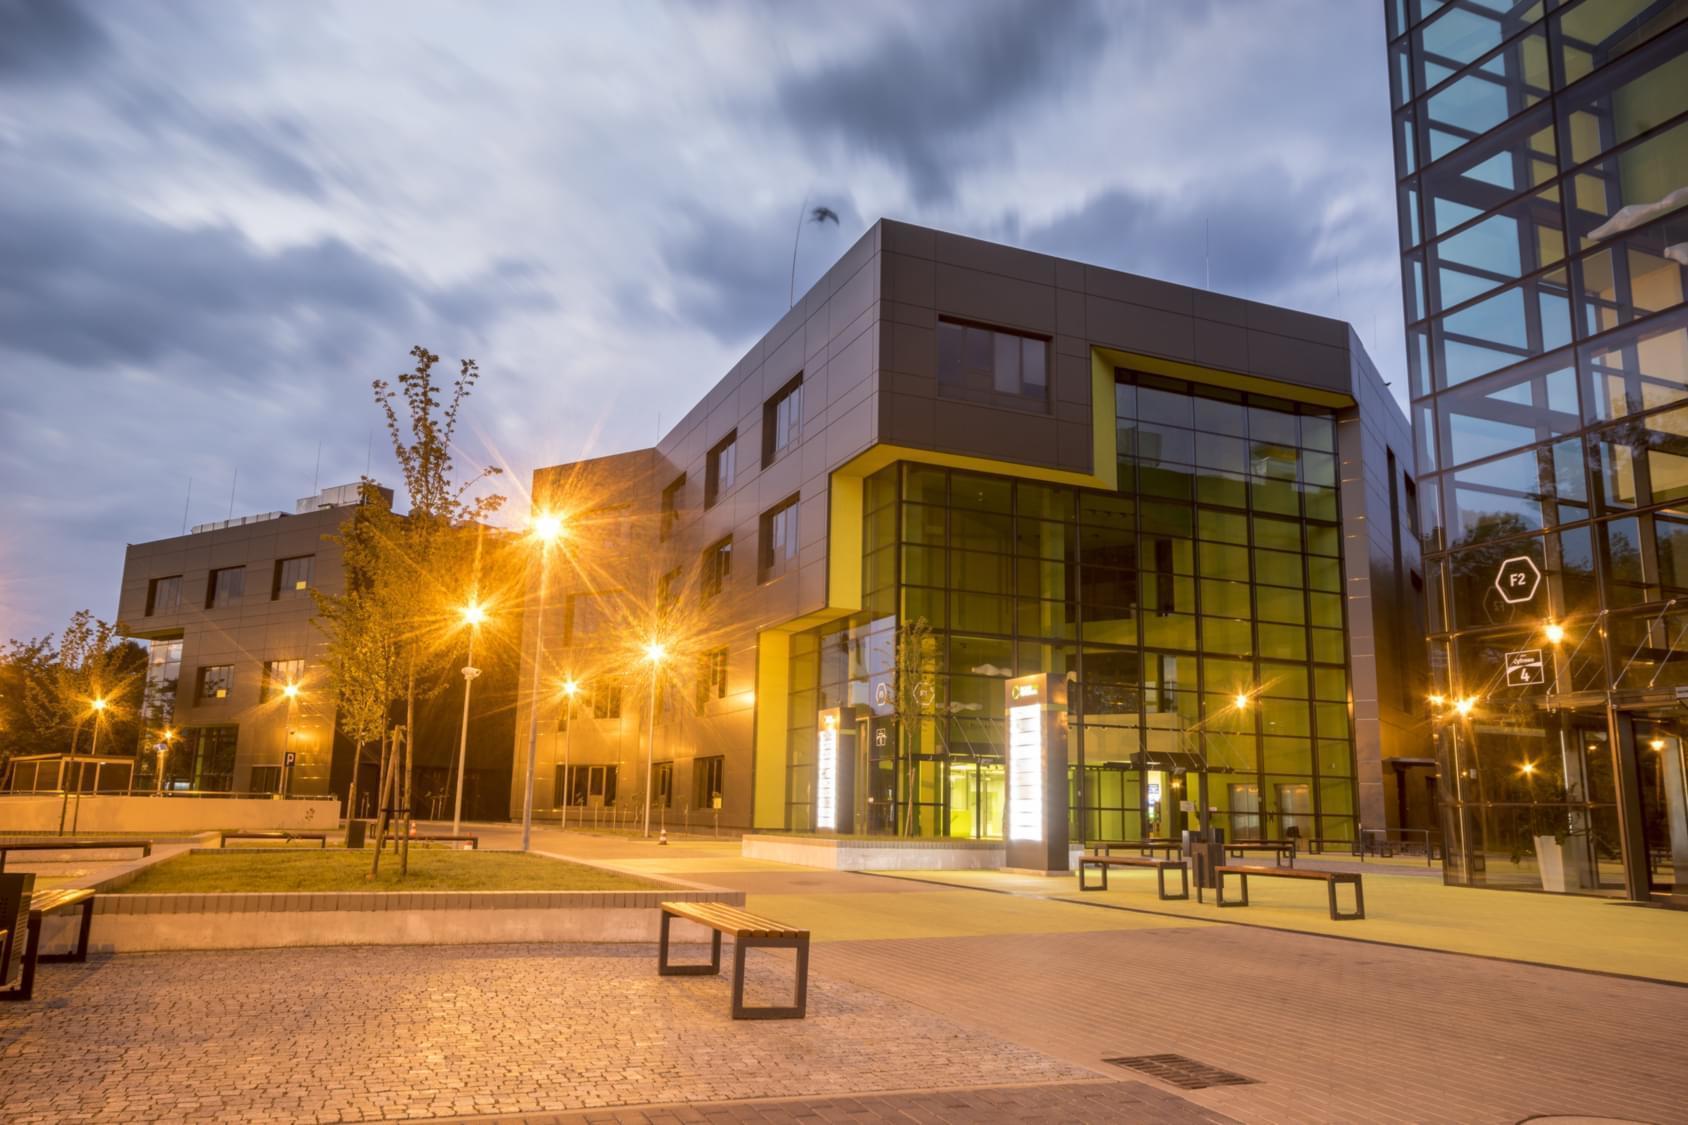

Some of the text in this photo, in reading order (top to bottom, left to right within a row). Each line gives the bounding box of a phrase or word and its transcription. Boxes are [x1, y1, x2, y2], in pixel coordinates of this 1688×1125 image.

[1509, 572, 1526, 587] F2
[1520, 668, 1530, 682] 4
[286, 753, 295, 766] P
